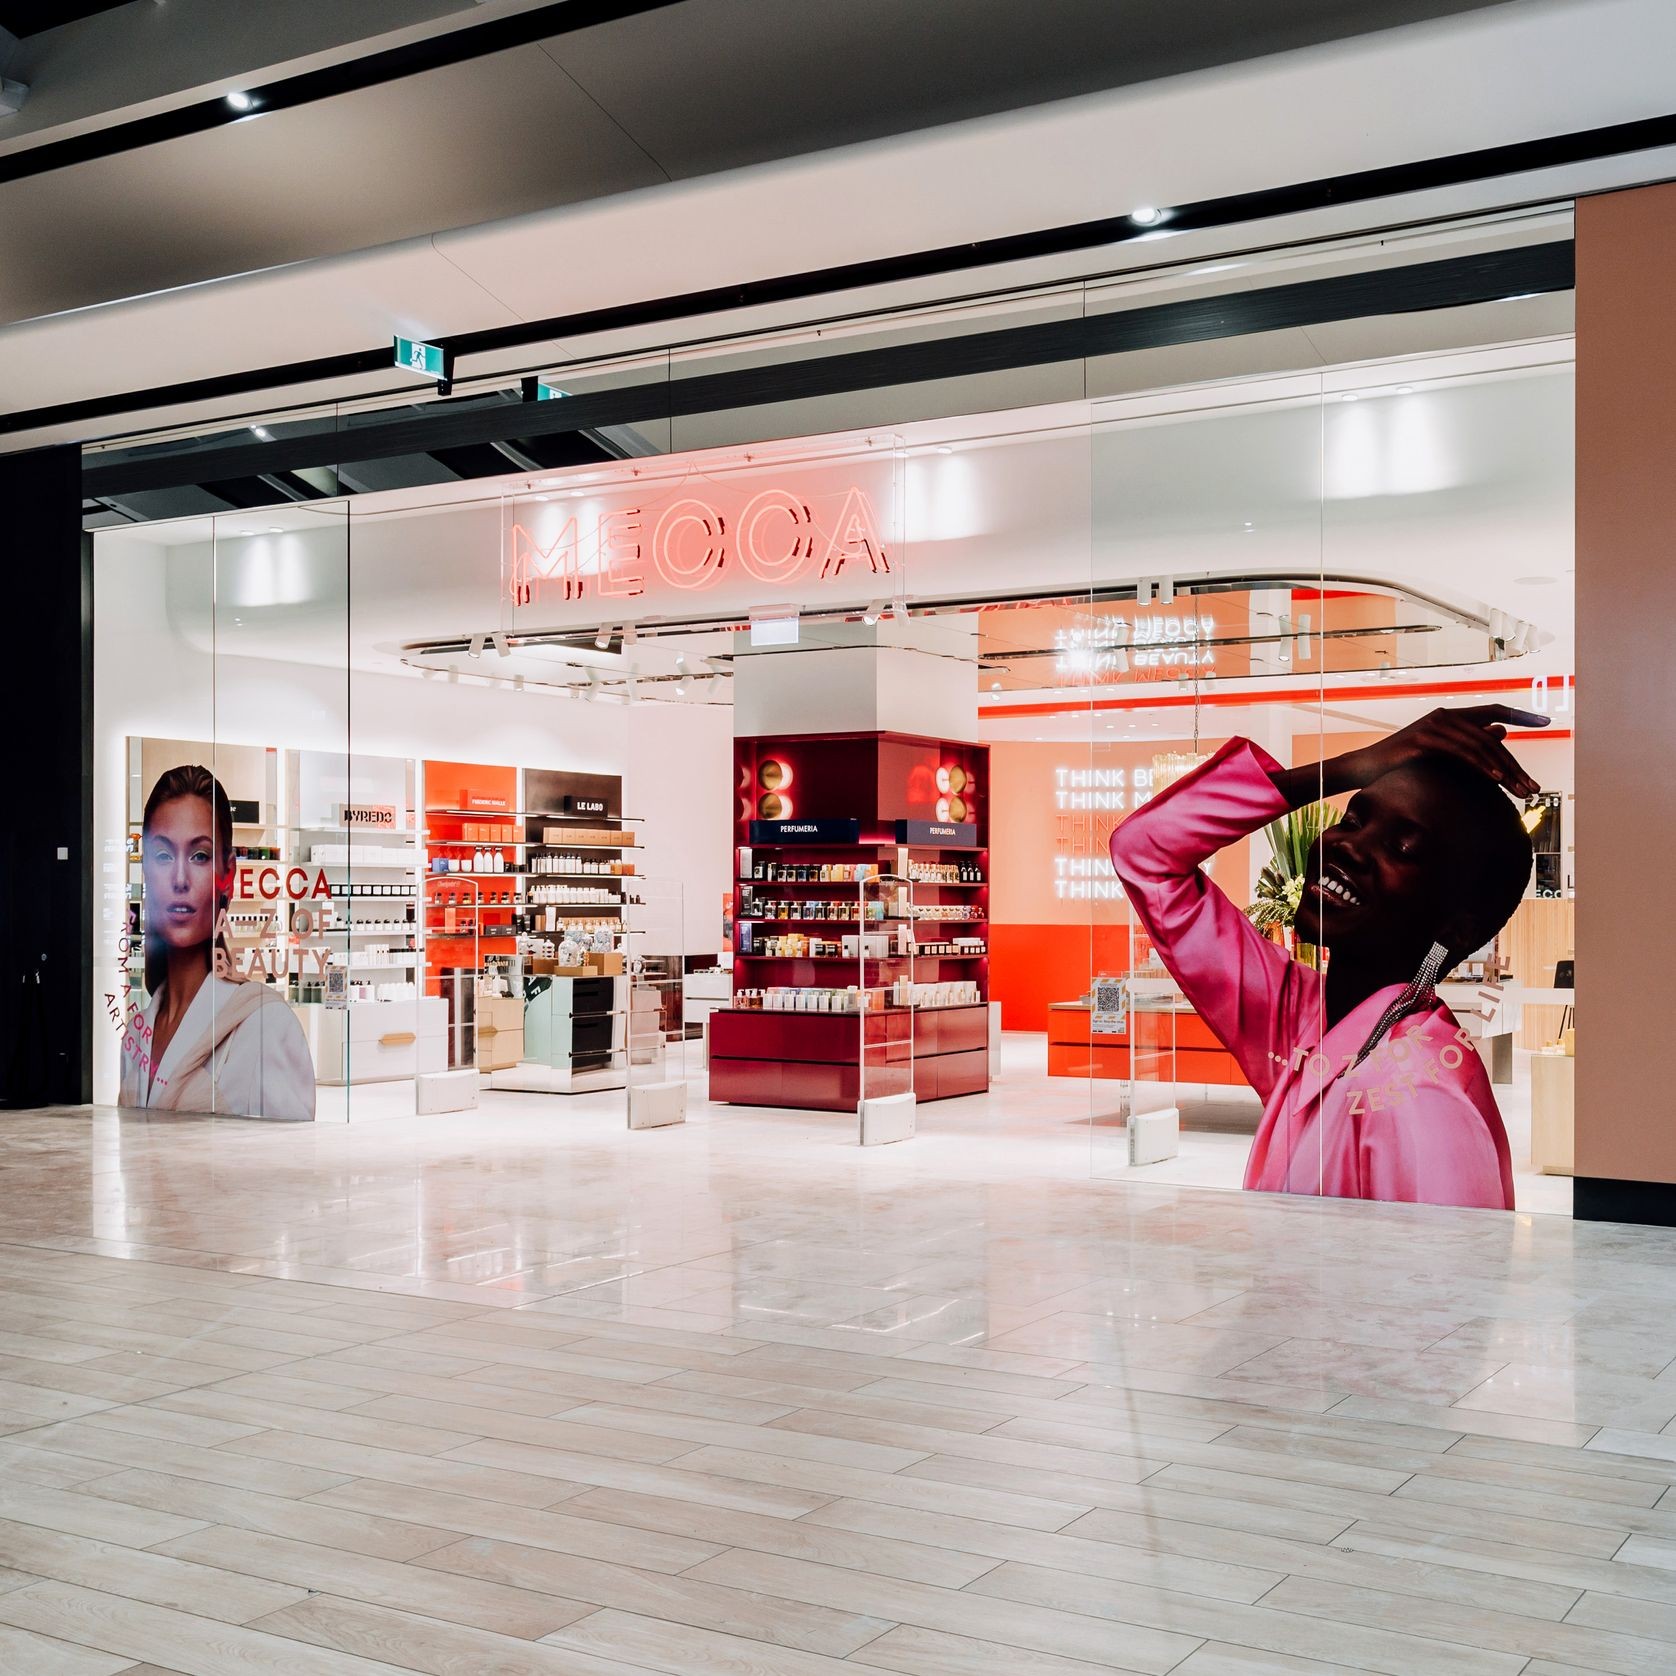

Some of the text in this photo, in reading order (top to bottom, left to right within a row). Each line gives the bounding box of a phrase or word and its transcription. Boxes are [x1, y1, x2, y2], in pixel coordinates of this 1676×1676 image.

[513, 487, 890, 606] MECCA
[1056, 769, 1125, 787] THINK
[577, 802, 603, 811] LE LABO
[1056, 791, 1125, 809] THINK
[344, 810, 392, 823] BYREDO
[780, 825, 818, 833] PERFUMERIA
[929, 827, 956, 836] PERFUMERIA
[1056, 837, 1110, 854] THIN
[1055, 858, 1114, 876] THIN
[1055, 880, 1124, 898] THINK
[291, 908, 332, 939] OF
[214, 947, 332, 981] BEAUTY
[120, 984, 131, 998] A
[127, 1002, 153, 1044] FOR
[1346, 953, 1511, 1115] ZEST FOR LIFE
[1342, 1054, 1361, 1078] Z
[1370, 1024, 1433, 1072] FOR
